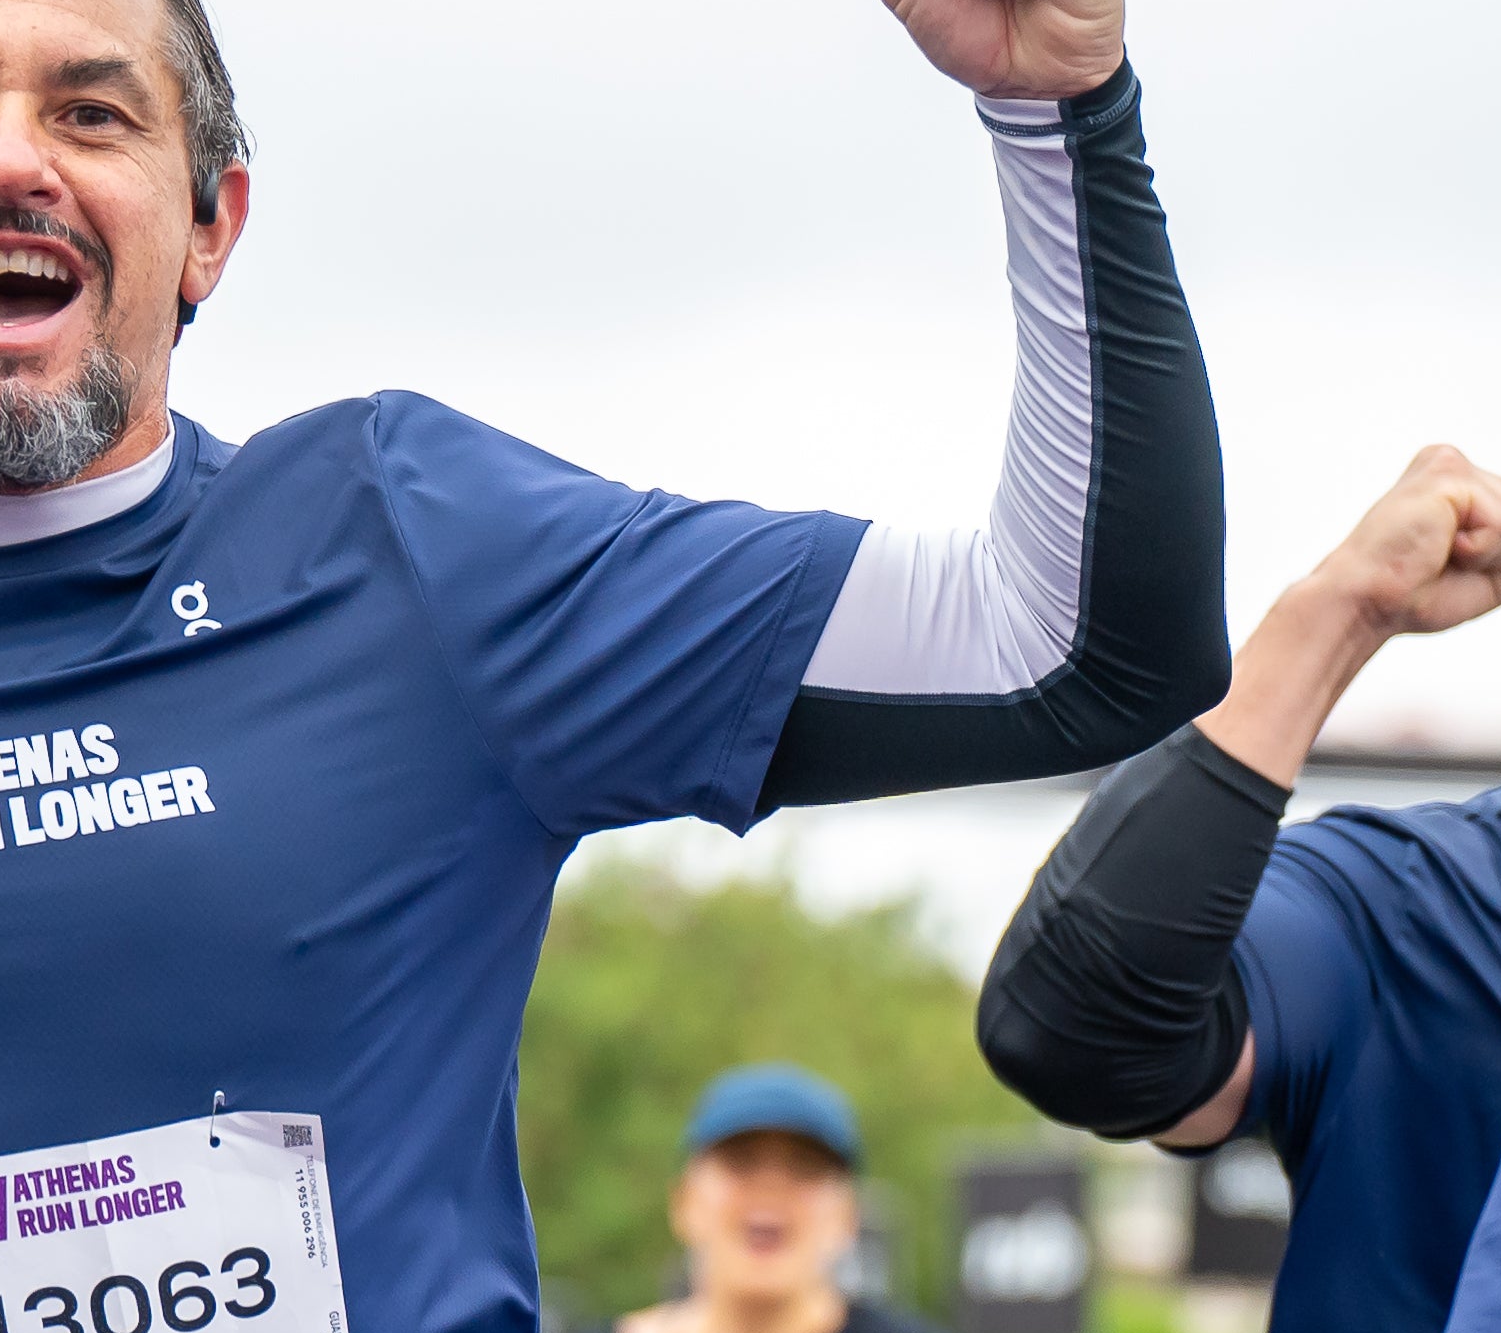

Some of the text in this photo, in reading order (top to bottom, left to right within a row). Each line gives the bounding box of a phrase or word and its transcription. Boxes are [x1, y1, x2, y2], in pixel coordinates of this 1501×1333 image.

[8, 766, 216, 847] LONGER
[13, 1155, 136, 1203] ATHENAS
[16, 1181, 187, 1238] RUN LONGER
